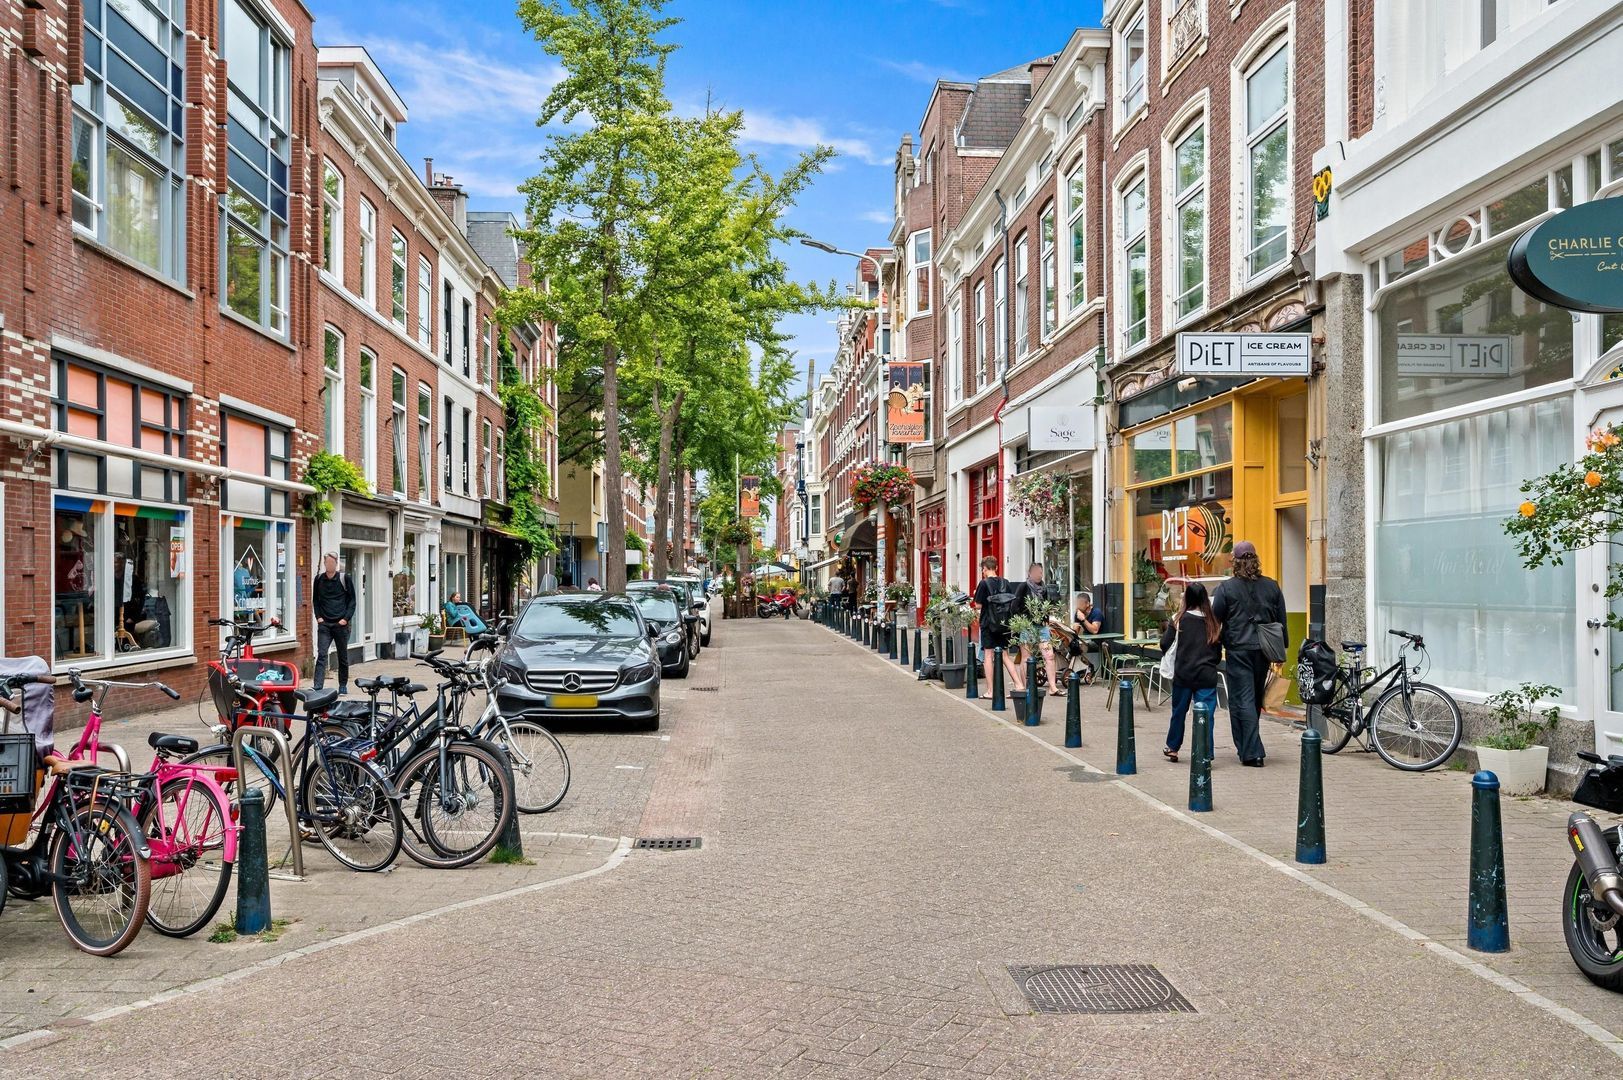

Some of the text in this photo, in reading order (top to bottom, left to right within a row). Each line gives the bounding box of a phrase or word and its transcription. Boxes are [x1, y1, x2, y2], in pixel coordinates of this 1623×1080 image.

[1548, 237, 1612, 250] CHARLIE
[1597, 261, 1618, 272] Cut
[1247, 342, 1302, 350] ICE CREAM
[1050, 428, 1076, 442] Sage
[170, 542, 184, 551] OPEN
